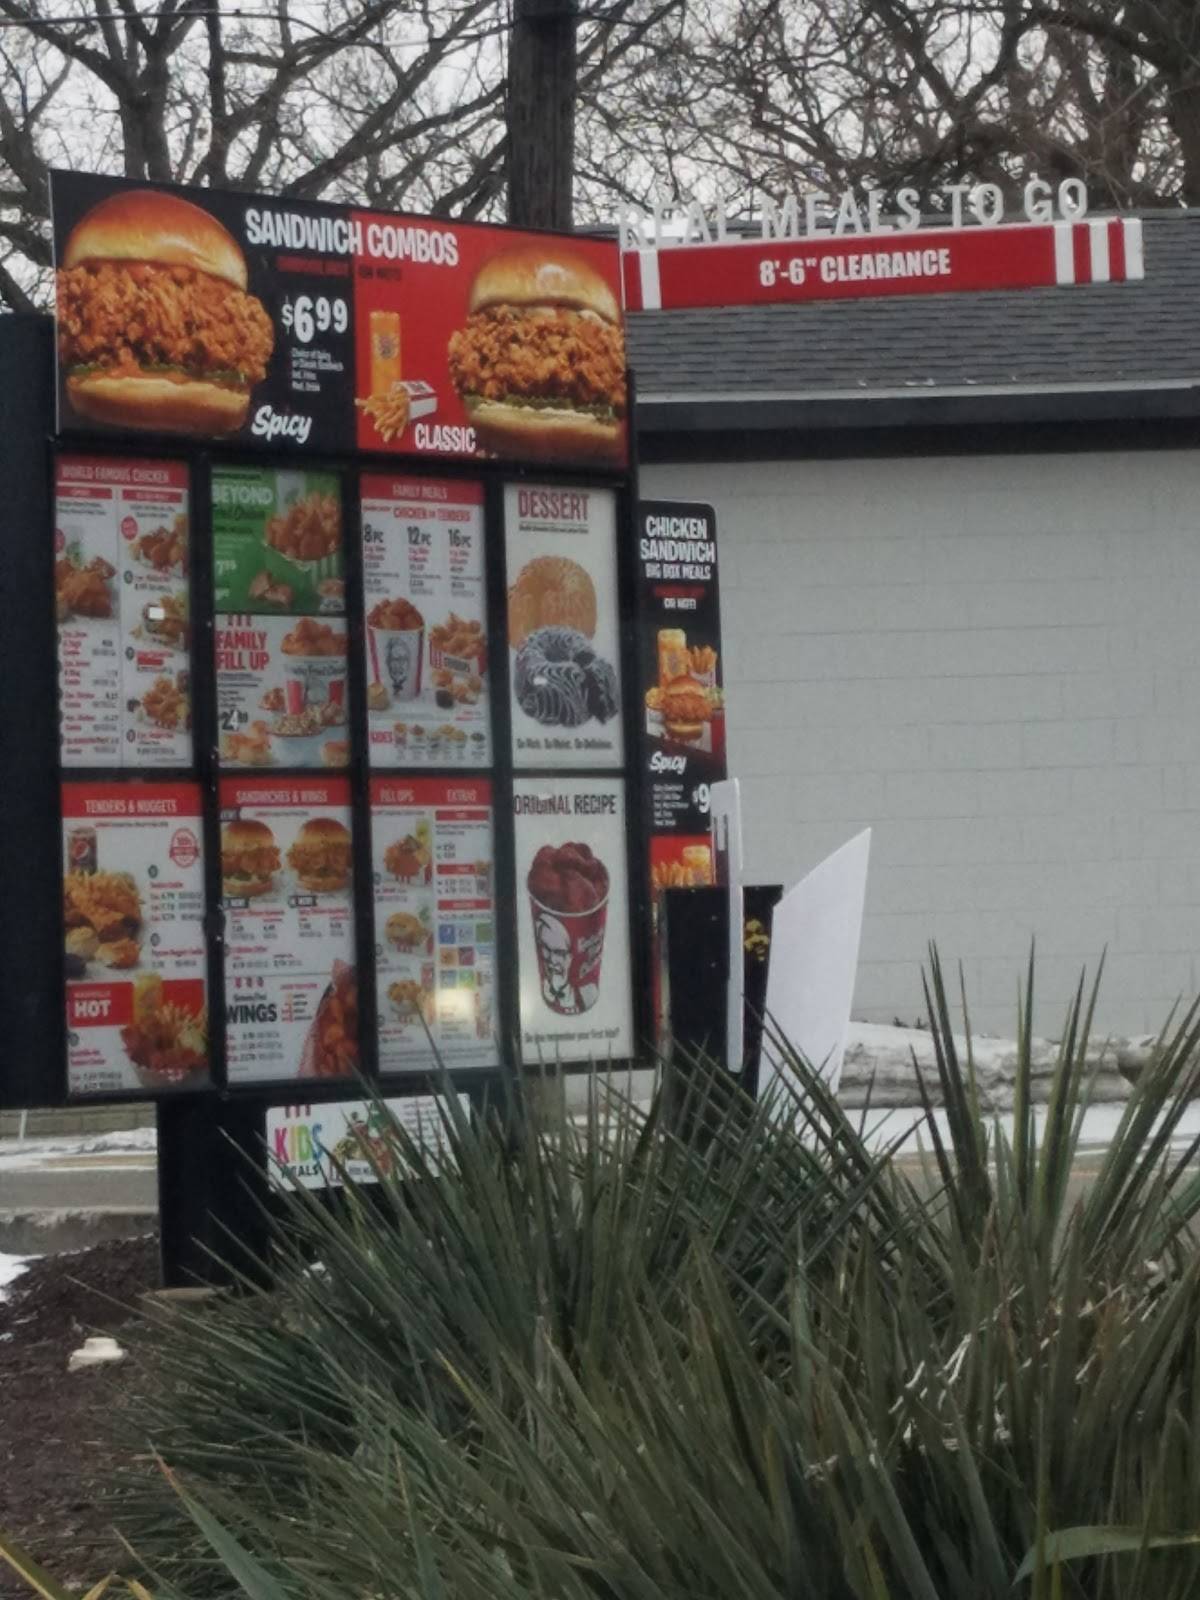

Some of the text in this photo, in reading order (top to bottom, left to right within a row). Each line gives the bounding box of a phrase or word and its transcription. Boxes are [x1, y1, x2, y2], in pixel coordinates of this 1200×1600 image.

[761, 187, 920, 240] MEALS
[943, 183, 1004, 227] TO
[1024, 178, 1087, 223] GO
[246, 208, 364, 256] SANDWICH
[368, 225, 459, 266] COMBOS
[820, 248, 951, 283] CLEARANCE
[252, 405, 312, 444] Spicy
[415, 423, 476, 453] CLASSIC
[212, 484, 273, 505] BEYOND
[519, 489, 590, 521] DESSERT
[646, 515, 707, 539] CHICKEN
[640, 538, 715, 563] SANDWICH
[216, 630, 267, 650] FAMILY
[216, 651, 246, 670] FILL
[249, 651, 270, 670] UP
[649, 751, 686, 775] Spicy
[574, 794, 616, 814] RECIPE
[75, 999, 111, 1018] HOT
[274, 1123, 322, 1164] KIDS
